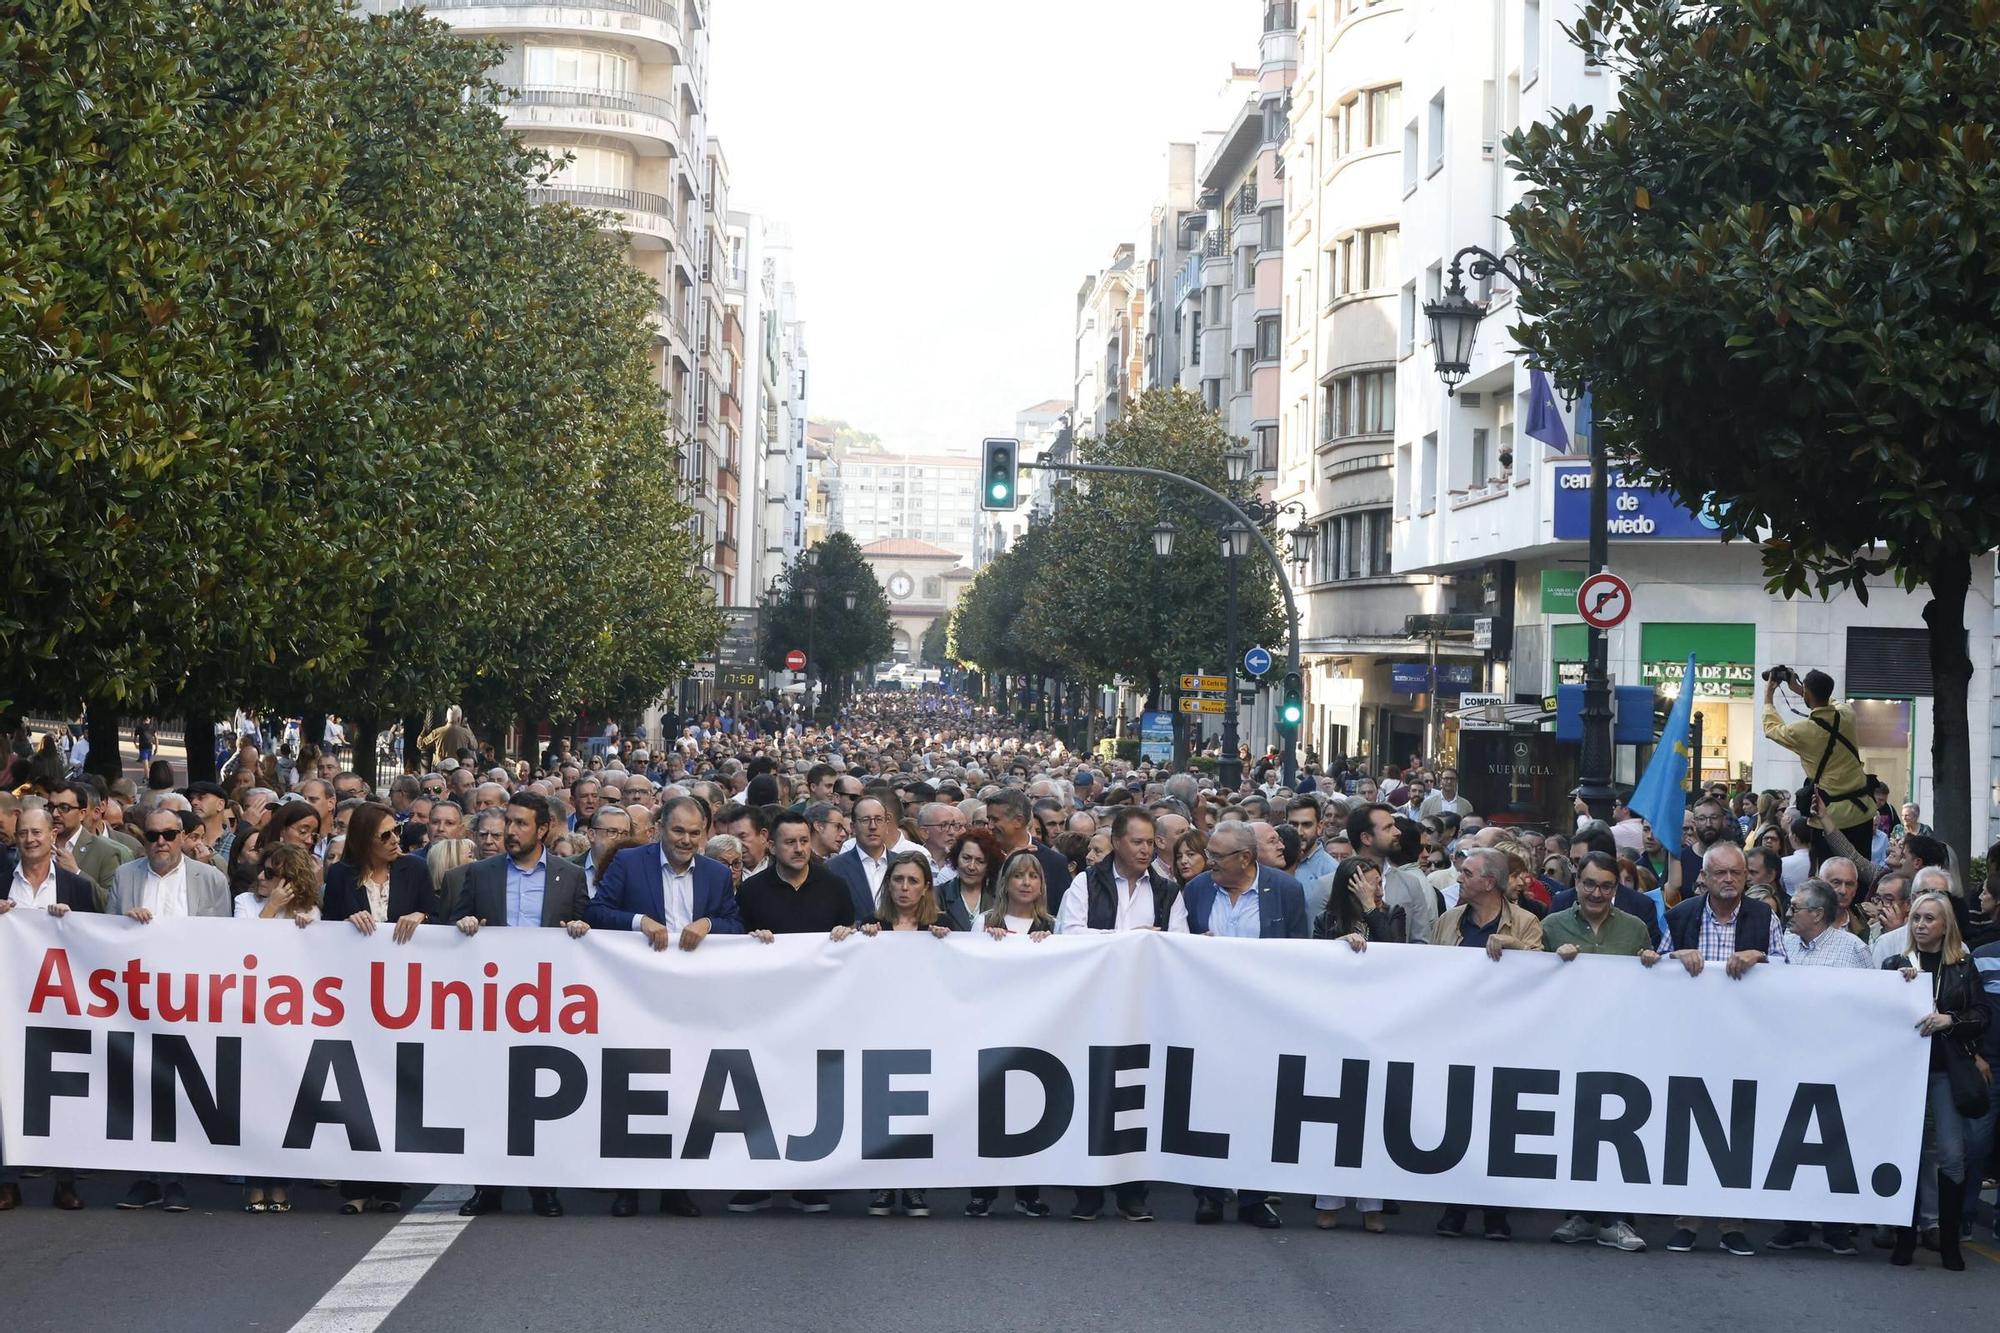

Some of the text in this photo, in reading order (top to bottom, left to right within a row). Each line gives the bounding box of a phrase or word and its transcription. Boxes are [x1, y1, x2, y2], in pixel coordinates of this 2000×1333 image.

[1616, 491, 1639, 511] de
[1607, 514, 1655, 534] viedo
[724, 674, 754, 685] 17:58
[1643, 664, 1752, 681] LA CAA DE LAS
[1464, 697, 1502, 706] COMPRO
[1546, 700, 1556, 708] A2
[1488, 764, 1554, 776] NUEVO CLA.
[31, 949, 597, 1034] Asturias Unida
[23, 1026, 1901, 1197] FIN AL PEAJE DEL HUERNA.
